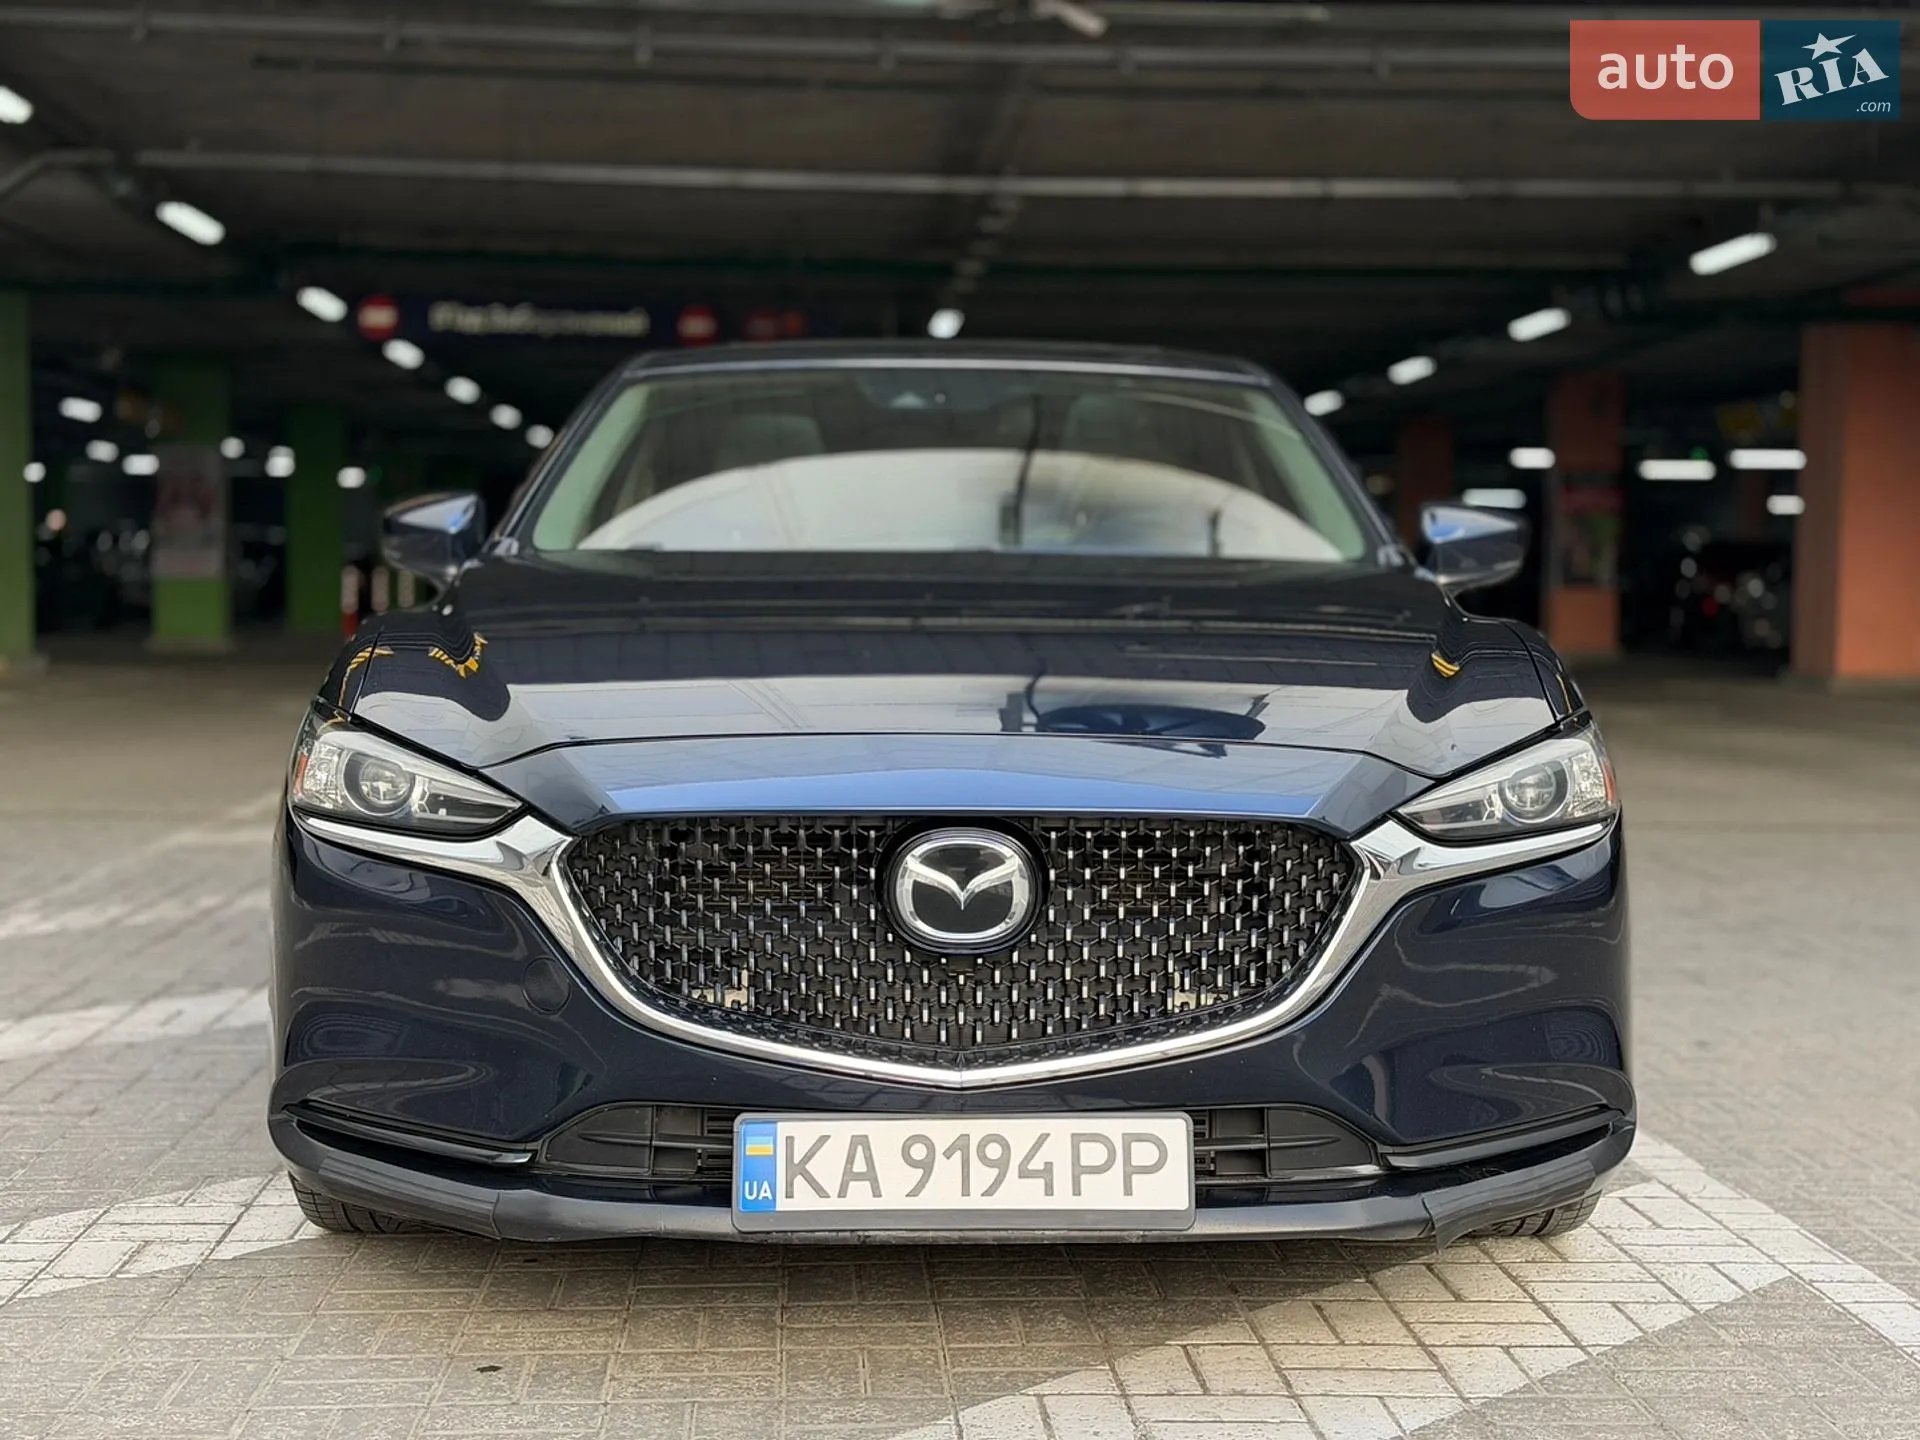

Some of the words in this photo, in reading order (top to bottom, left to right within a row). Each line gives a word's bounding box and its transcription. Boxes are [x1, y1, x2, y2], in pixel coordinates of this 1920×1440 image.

[785, 1134, 883, 1199] KA
[901, 1132, 1054, 1198] 9194
[1071, 1132, 1168, 1197] PP
[744, 1181, 773, 1201] UA
